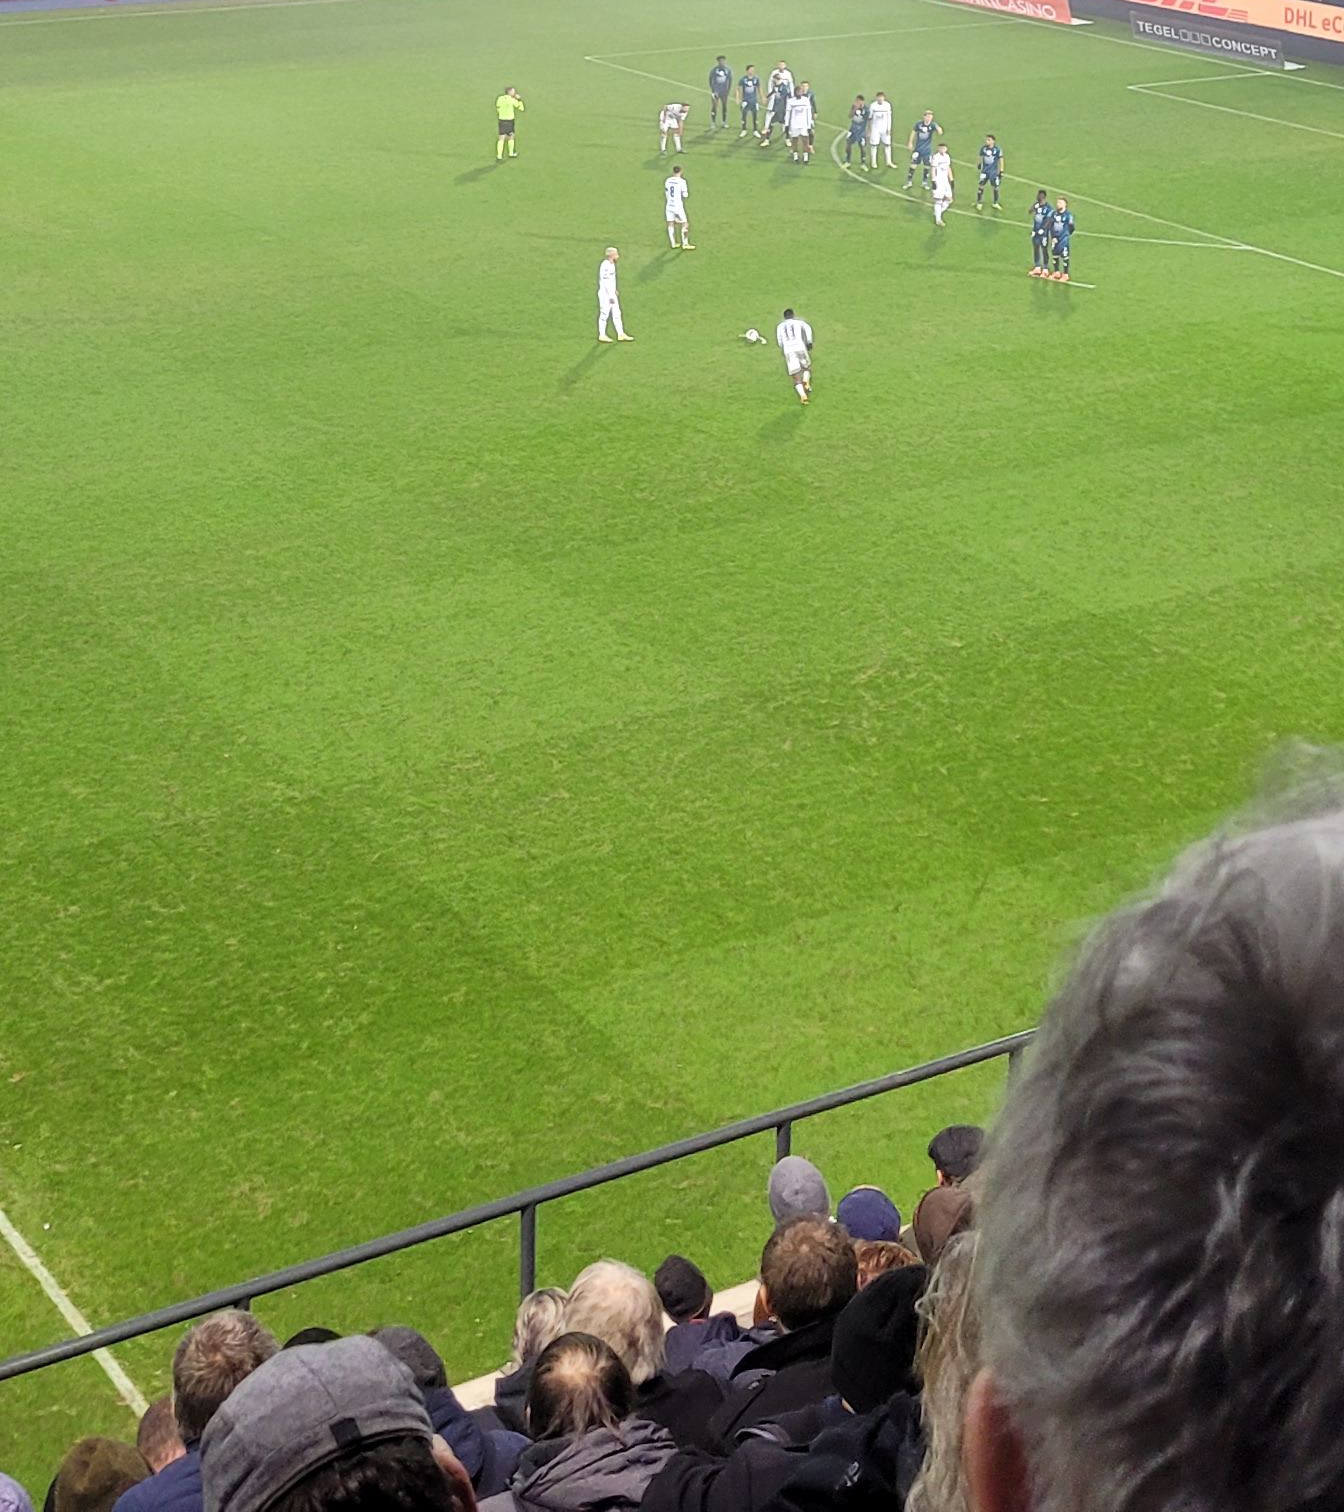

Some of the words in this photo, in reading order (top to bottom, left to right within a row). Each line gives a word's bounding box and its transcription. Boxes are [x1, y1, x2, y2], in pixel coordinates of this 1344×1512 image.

[1284, 7, 1317, 30] DHL
[1136, 20, 1180, 39] TEGEL
[1212, 36, 1278, 59] CONCEPT
[783, 324, 797, 342] 11
